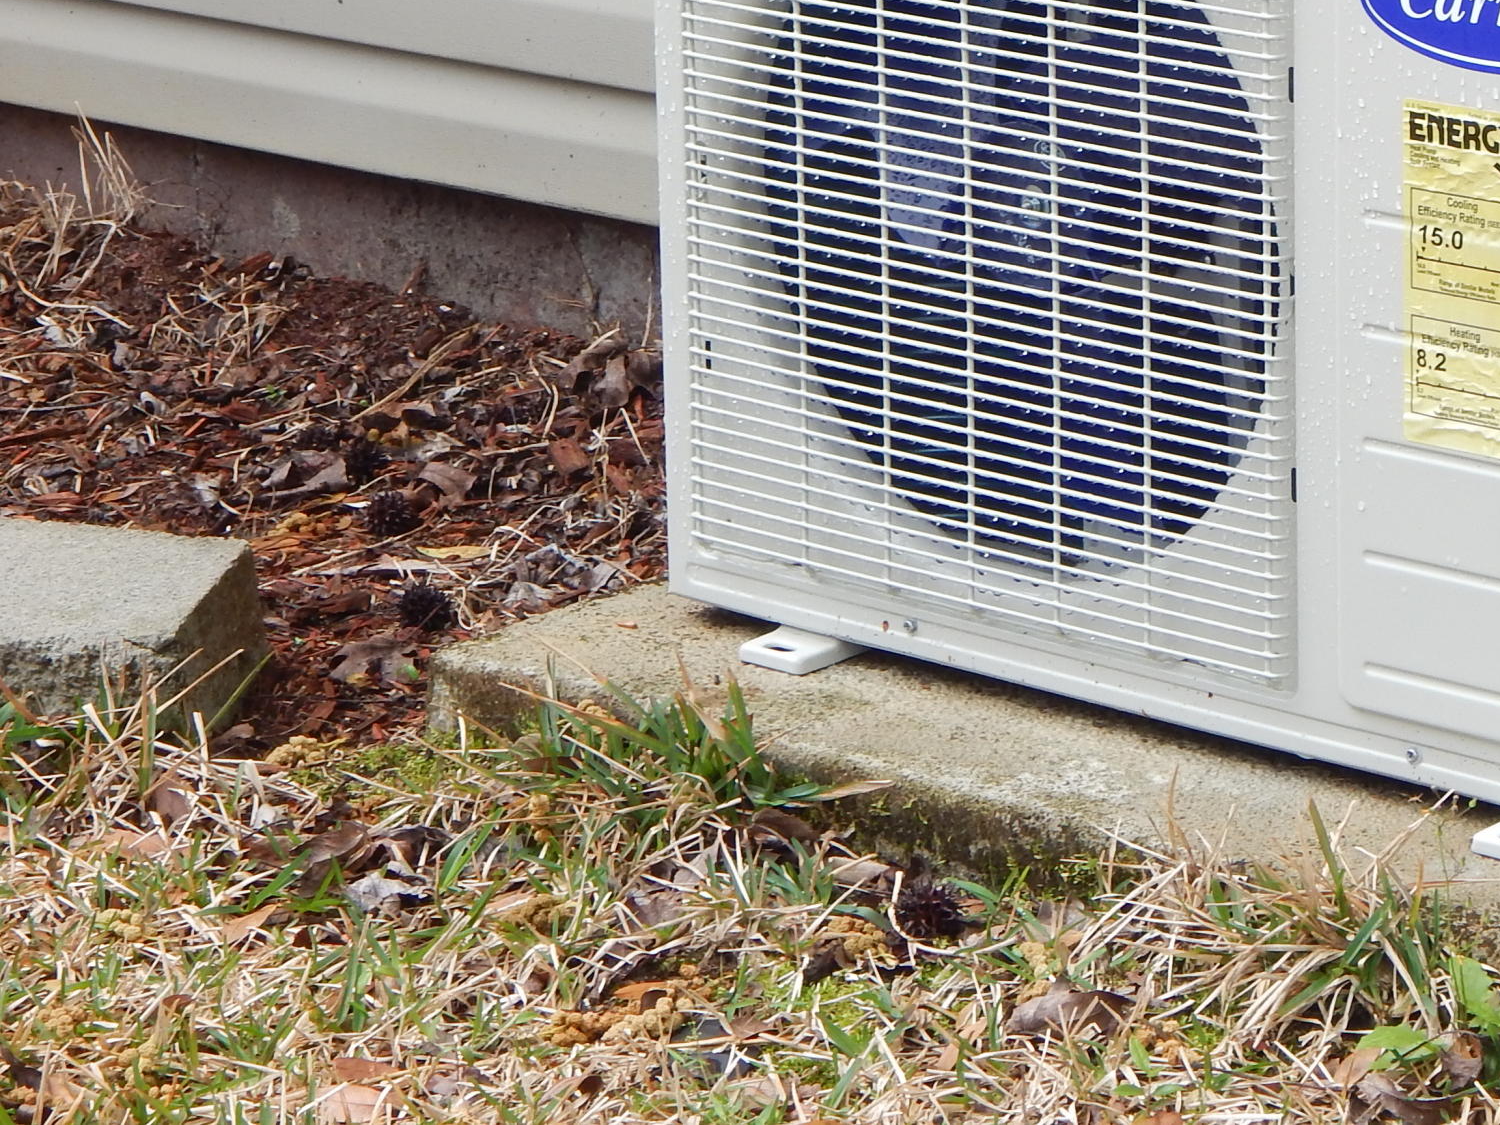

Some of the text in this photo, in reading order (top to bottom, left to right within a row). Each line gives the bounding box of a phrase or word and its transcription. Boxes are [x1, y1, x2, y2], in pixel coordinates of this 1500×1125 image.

[1418, 205, 1457, 223] Efficiency
[1460, 213, 1485, 228] Rating
[1447, 197, 1478, 213] Cooling
[1419, 224, 1463, 249] 15.0
[1422, 334, 1460, 352] Efficiency
[1463, 341, 1489, 358] Rating
[1449, 327, 1481, 343] Heating
[1417, 349, 1447, 372] 8.2
